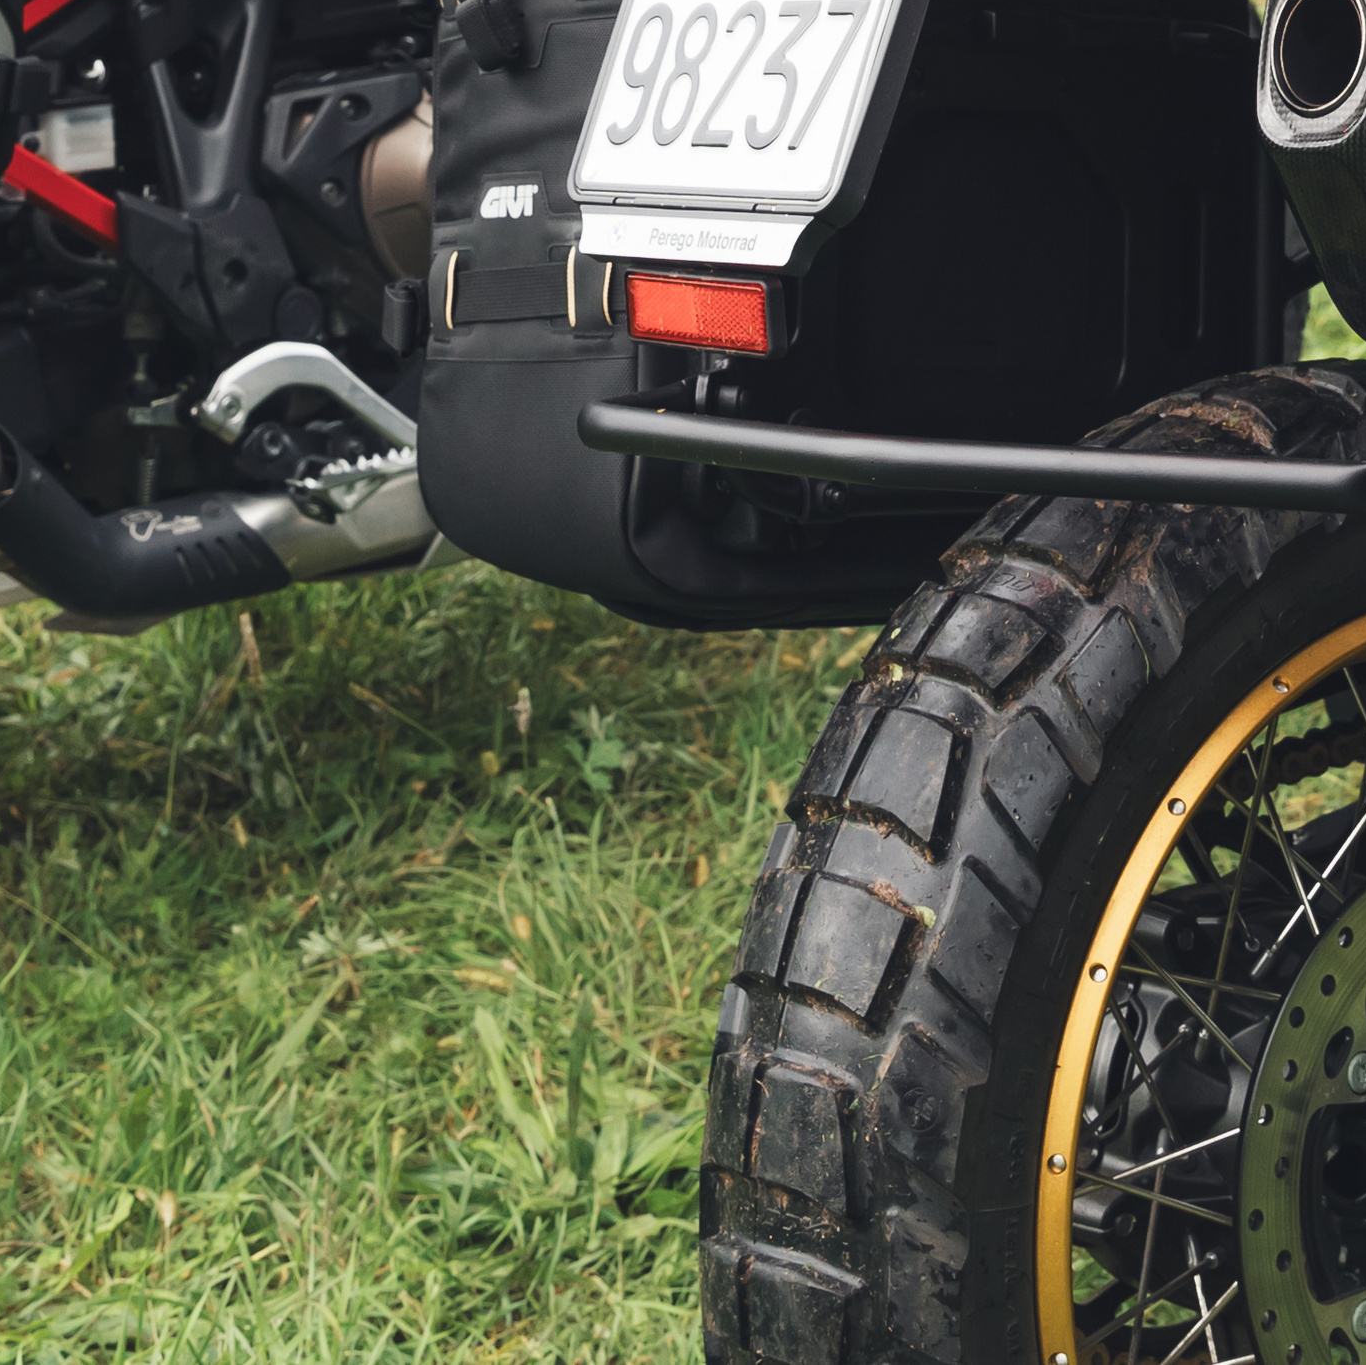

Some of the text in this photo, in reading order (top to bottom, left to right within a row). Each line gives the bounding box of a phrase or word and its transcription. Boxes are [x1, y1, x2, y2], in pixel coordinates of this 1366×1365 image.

[480, 184, 539, 219] GIVI
[649, 228, 758, 251] Perego Motorrad
